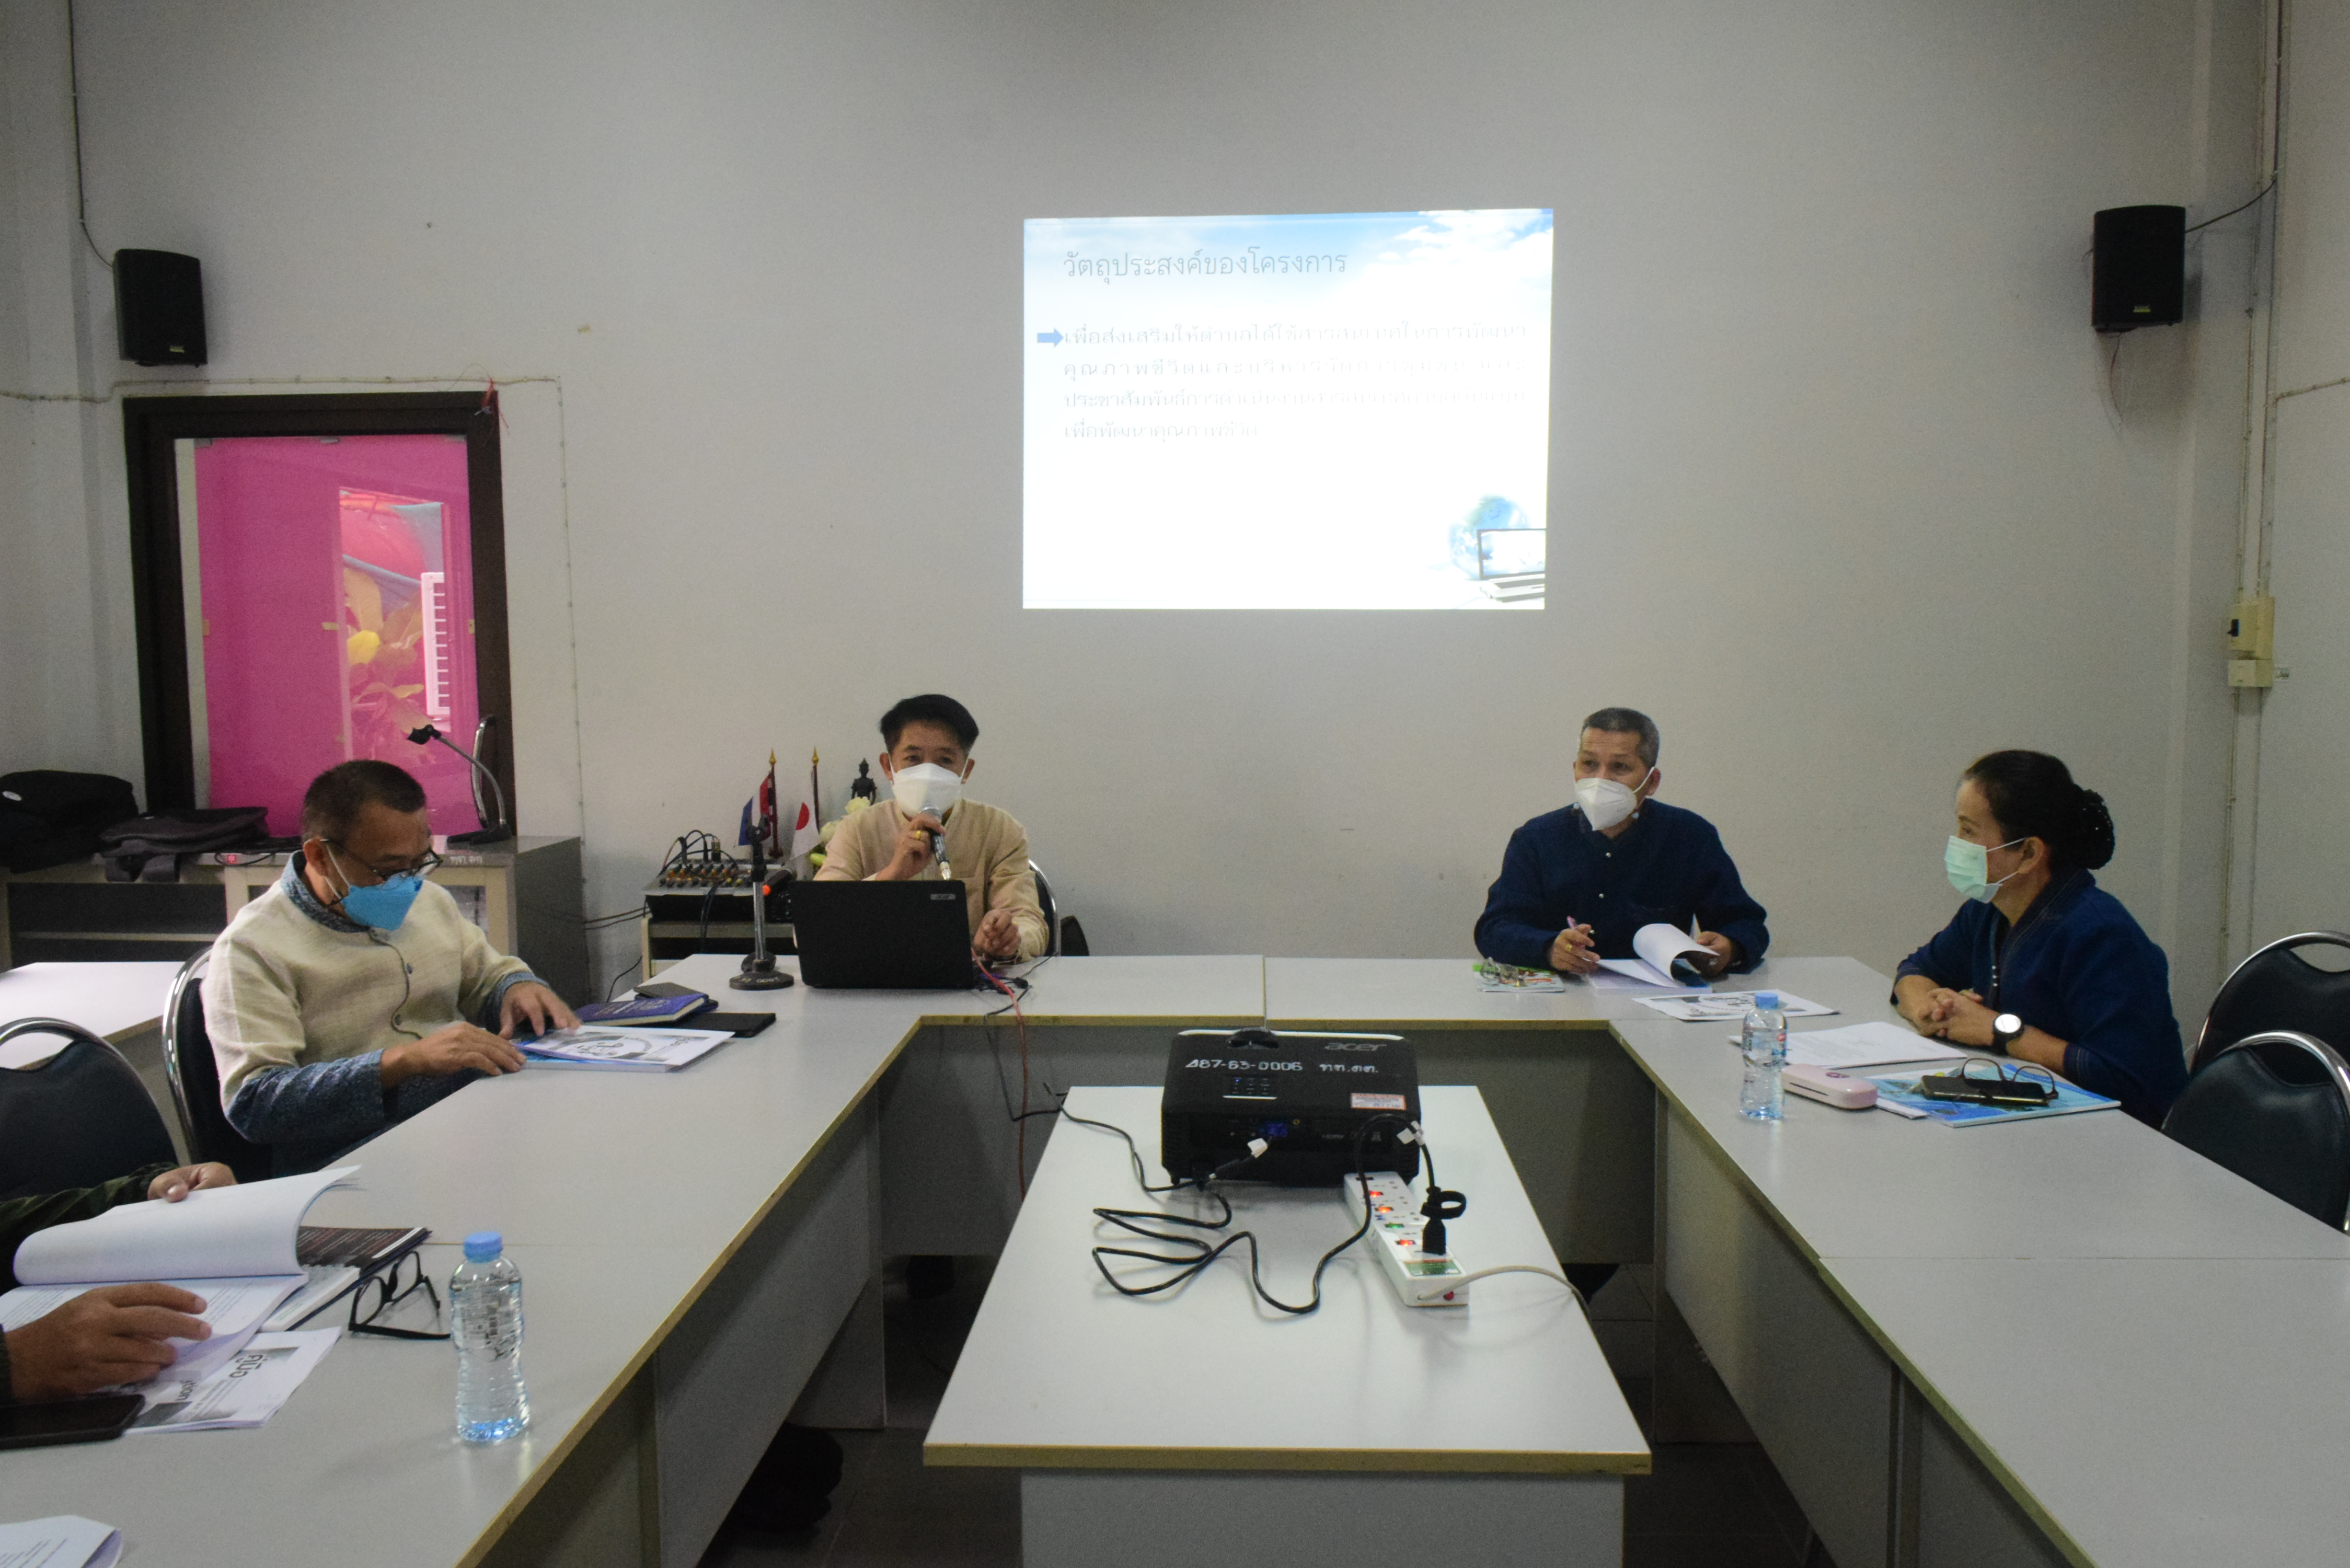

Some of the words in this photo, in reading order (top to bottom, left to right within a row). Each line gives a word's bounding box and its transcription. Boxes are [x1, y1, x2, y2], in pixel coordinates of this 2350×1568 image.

[1063, 246, 1347, 285] วัตถุประสงค์ของโครงการ
[1324, 1042, 1387, 1051] acer
[1185, 1059, 1303, 1071] 487-63-0006
